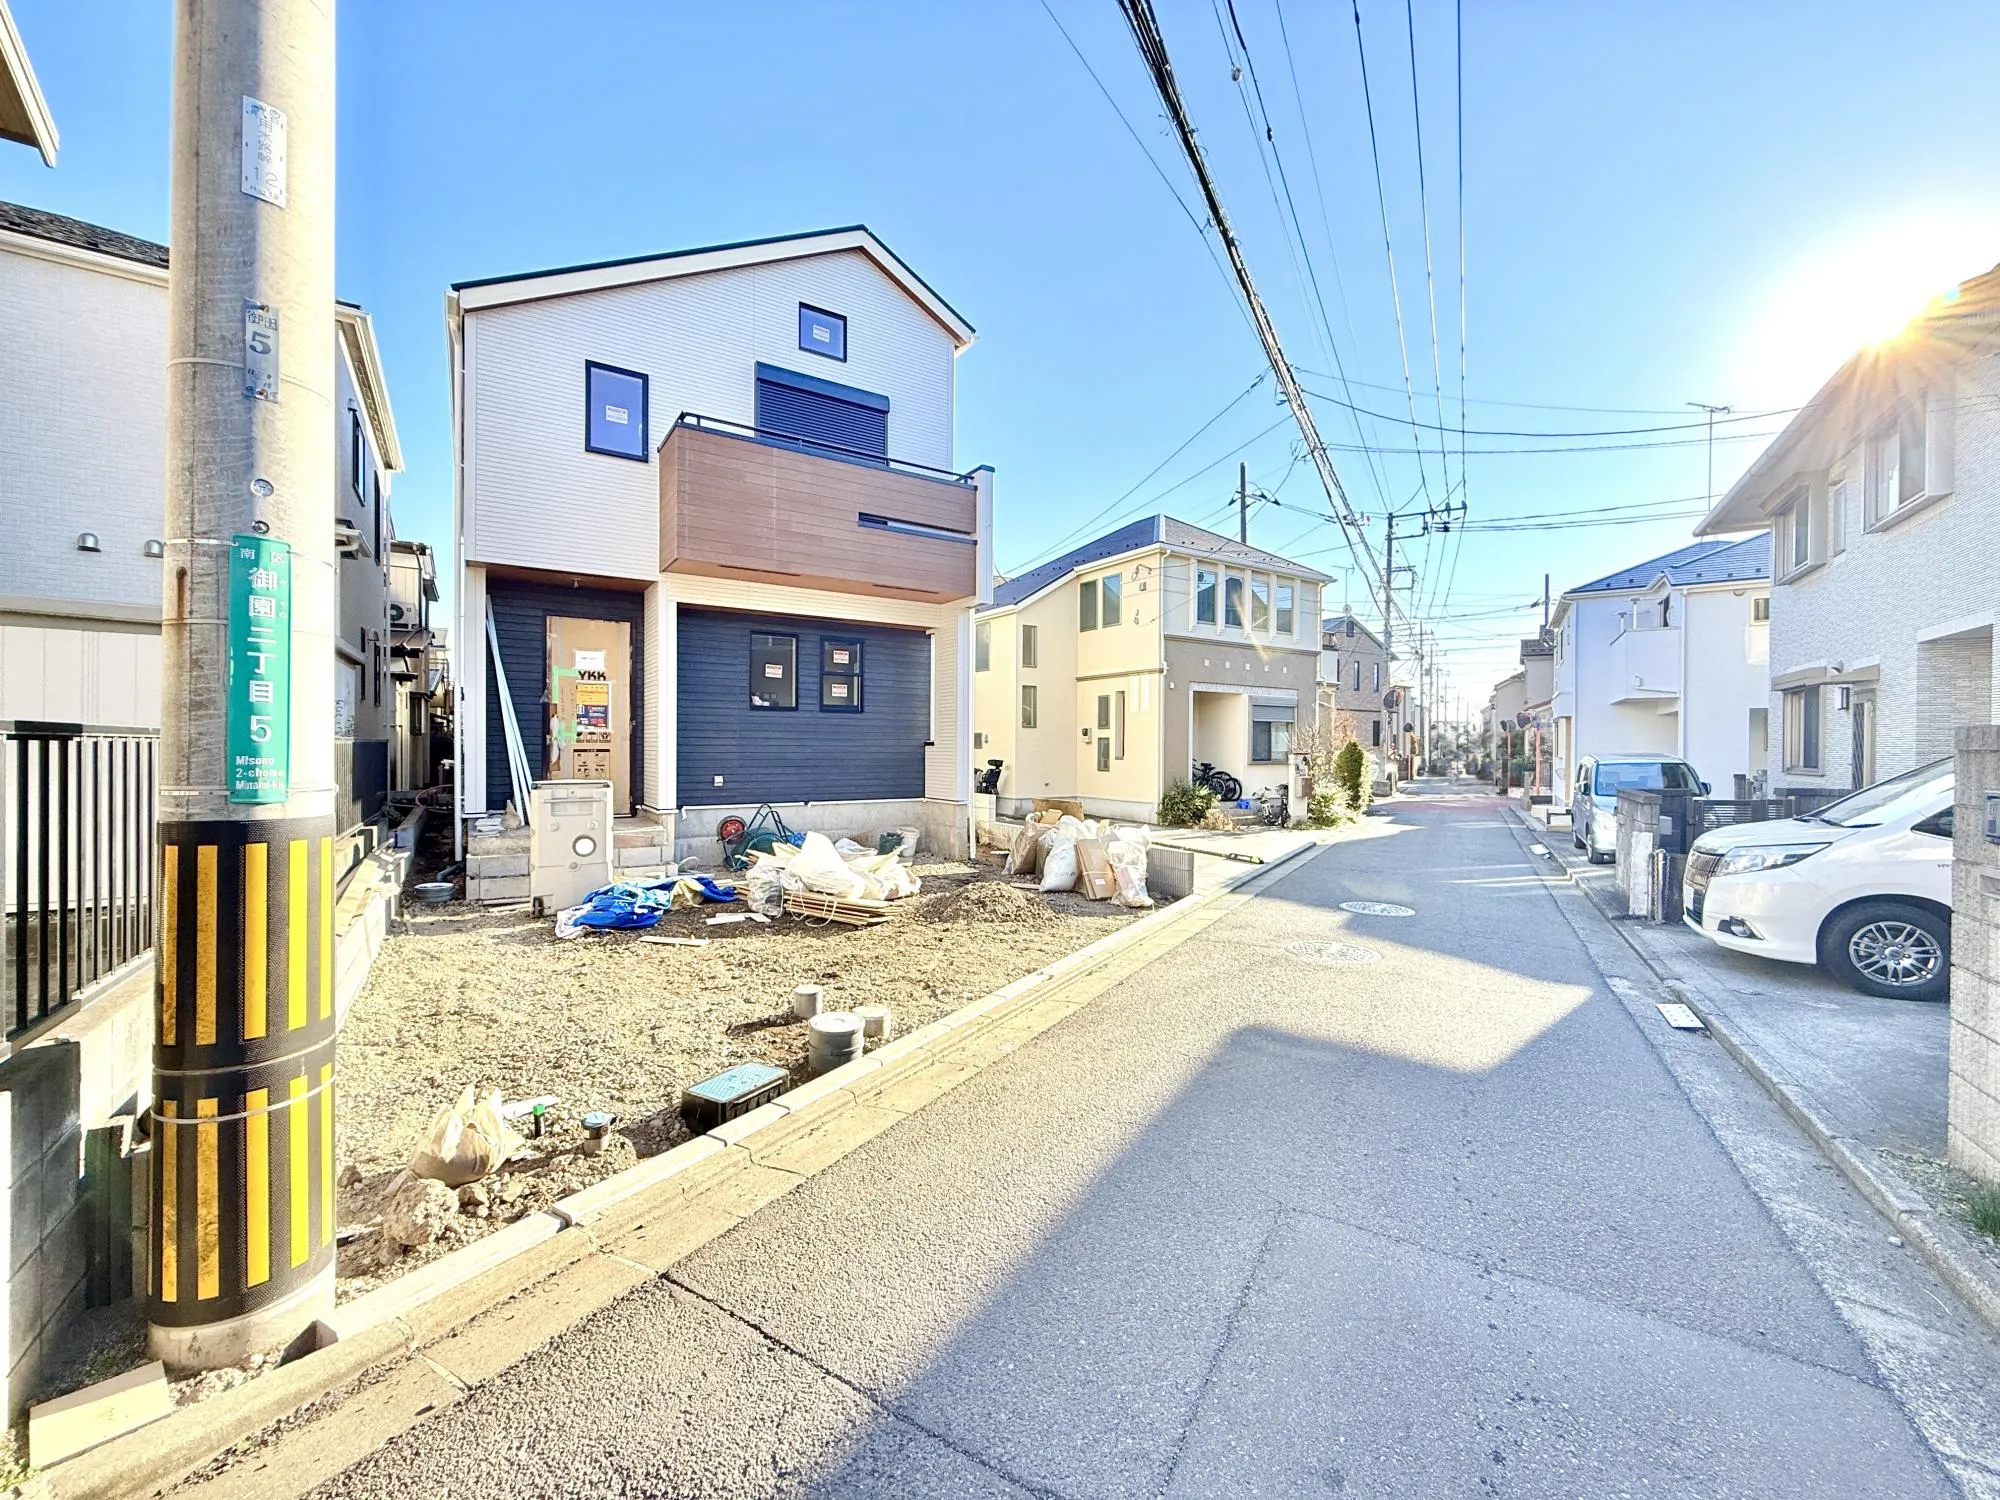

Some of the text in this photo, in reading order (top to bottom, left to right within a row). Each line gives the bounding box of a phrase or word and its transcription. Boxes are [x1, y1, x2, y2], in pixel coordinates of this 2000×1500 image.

[249, 330, 272, 355] 5
[578, 670, 607, 681] YKK
[235, 755, 275, 766] Misono
